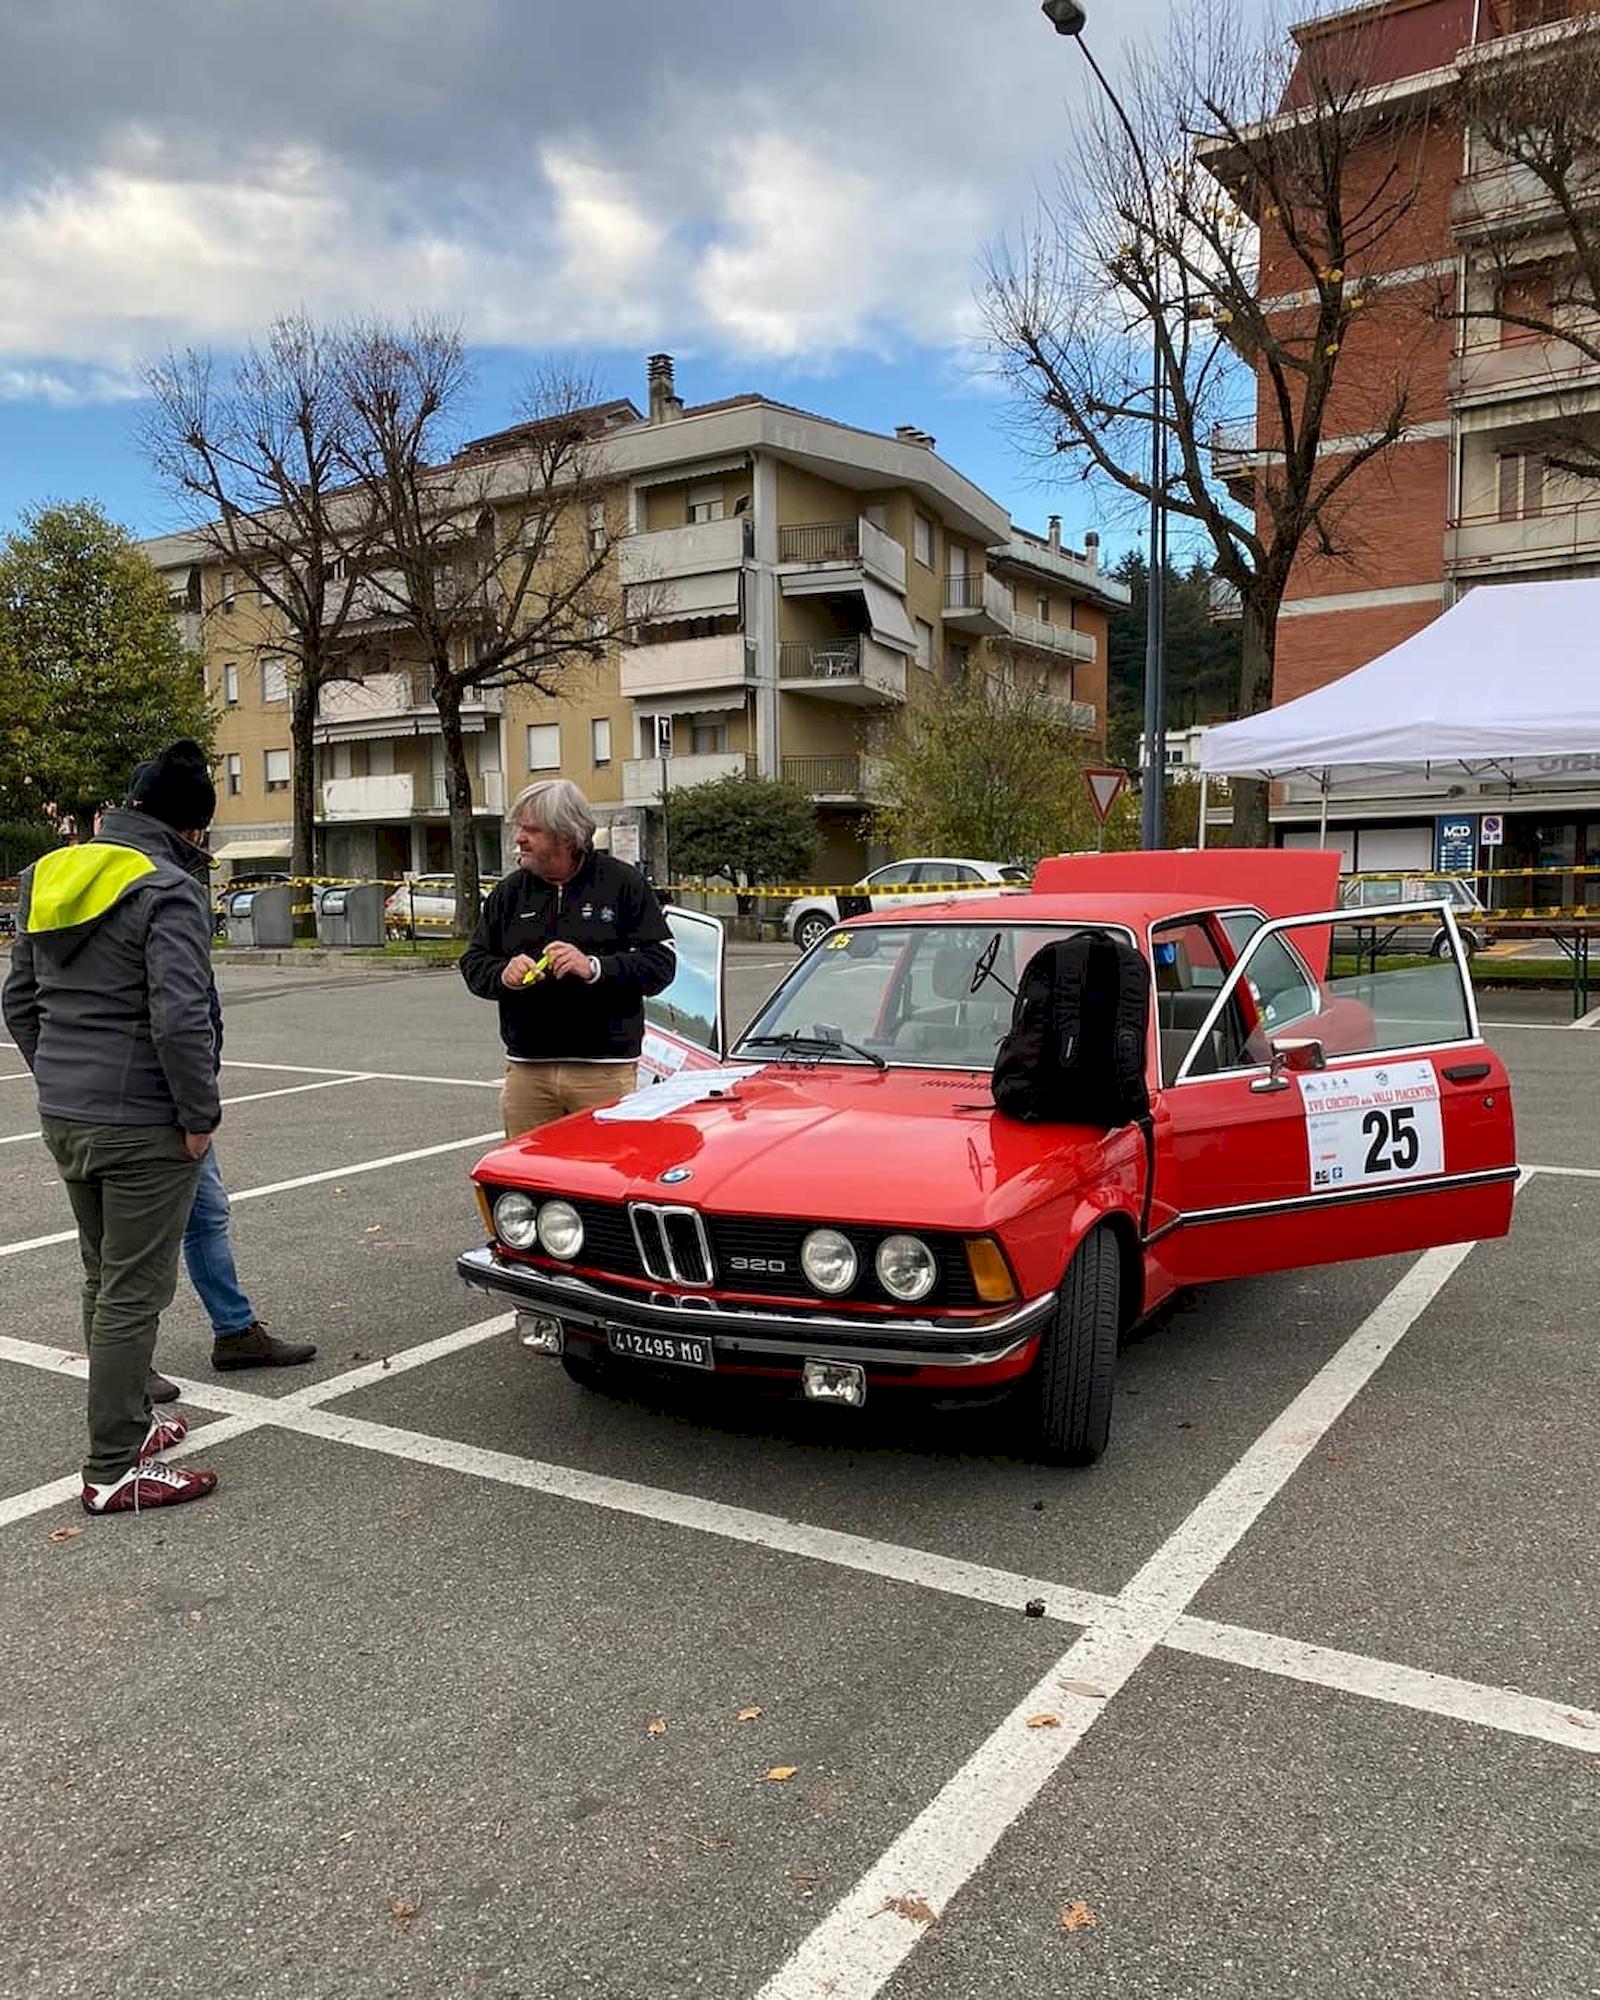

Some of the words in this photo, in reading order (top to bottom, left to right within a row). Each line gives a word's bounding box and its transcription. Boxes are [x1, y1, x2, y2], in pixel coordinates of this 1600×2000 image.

[826, 932, 854, 949] 25
[1362, 1106, 1420, 1174] 25
[730, 1256, 786, 1273] 320
[616, 1332, 675, 1359] 412495
[680, 1341, 702, 1362] MO
